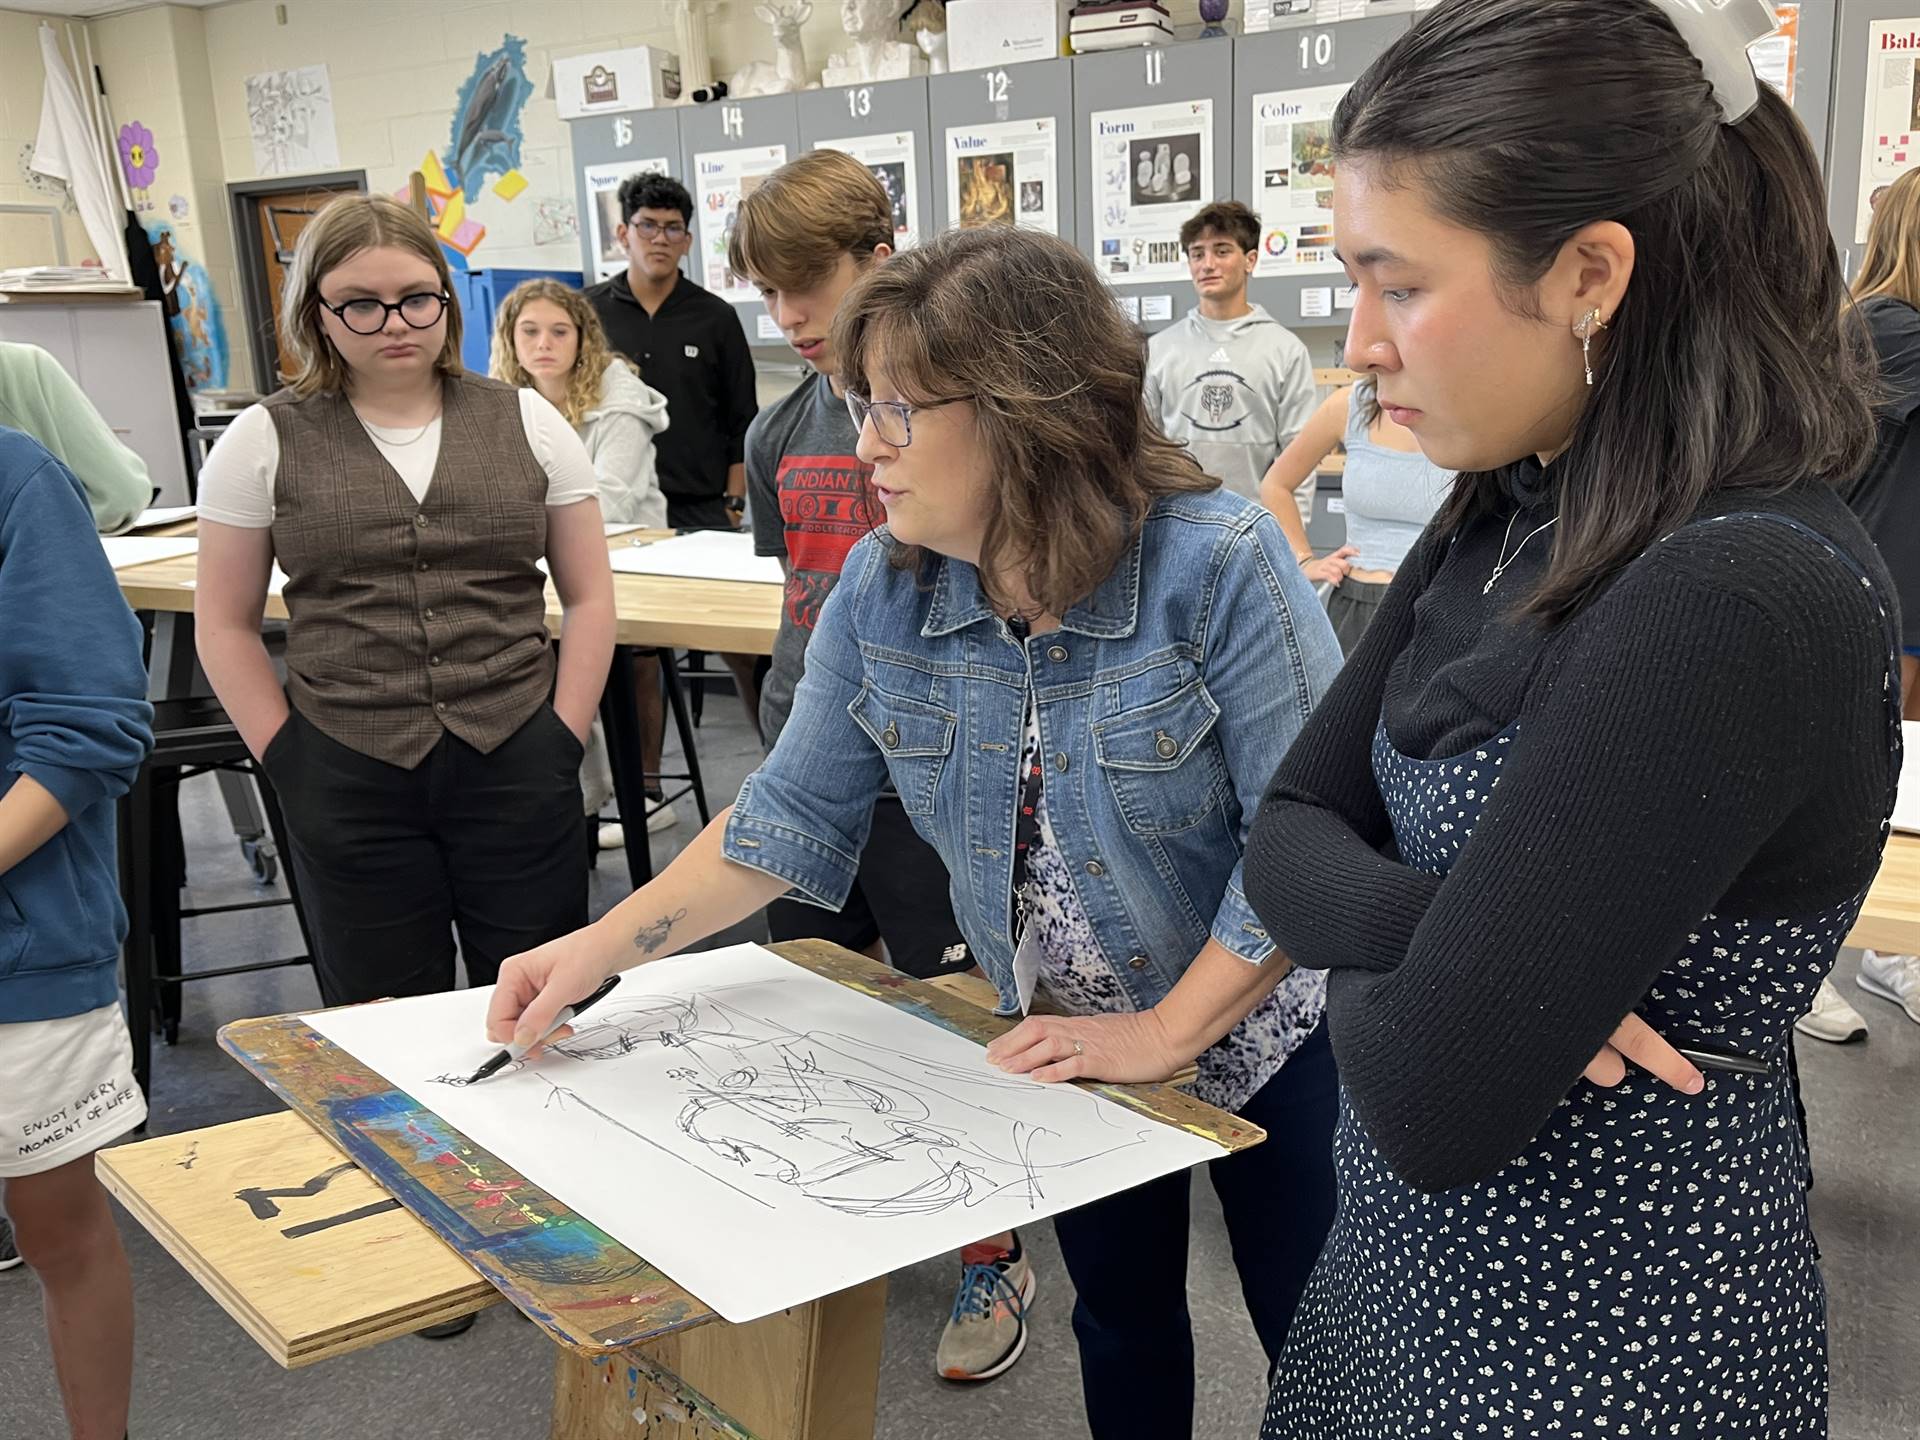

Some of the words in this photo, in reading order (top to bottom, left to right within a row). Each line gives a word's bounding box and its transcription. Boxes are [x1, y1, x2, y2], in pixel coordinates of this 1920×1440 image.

[1299, 34, 1331, 69] 10
[1146, 50, 1161, 84] 11
[986, 71, 1009, 101] 12
[849, 90, 871, 117] 13
[1261, 103, 1302, 118] Color
[722, 107, 743, 137] 14
[1099, 121, 1135, 135] Form
[954, 136, 987, 149] Value
[701, 161, 724, 174] Line
[793, 471, 850, 489] INDIAN
[18, 1118, 82, 1155] MOMENT
[87, 1105, 103, 1121] OF
[106, 1088, 134, 1110] LIFE
[22, 1107, 68, 1136] ENJOY
[74, 1079, 117, 1110] EVERY
